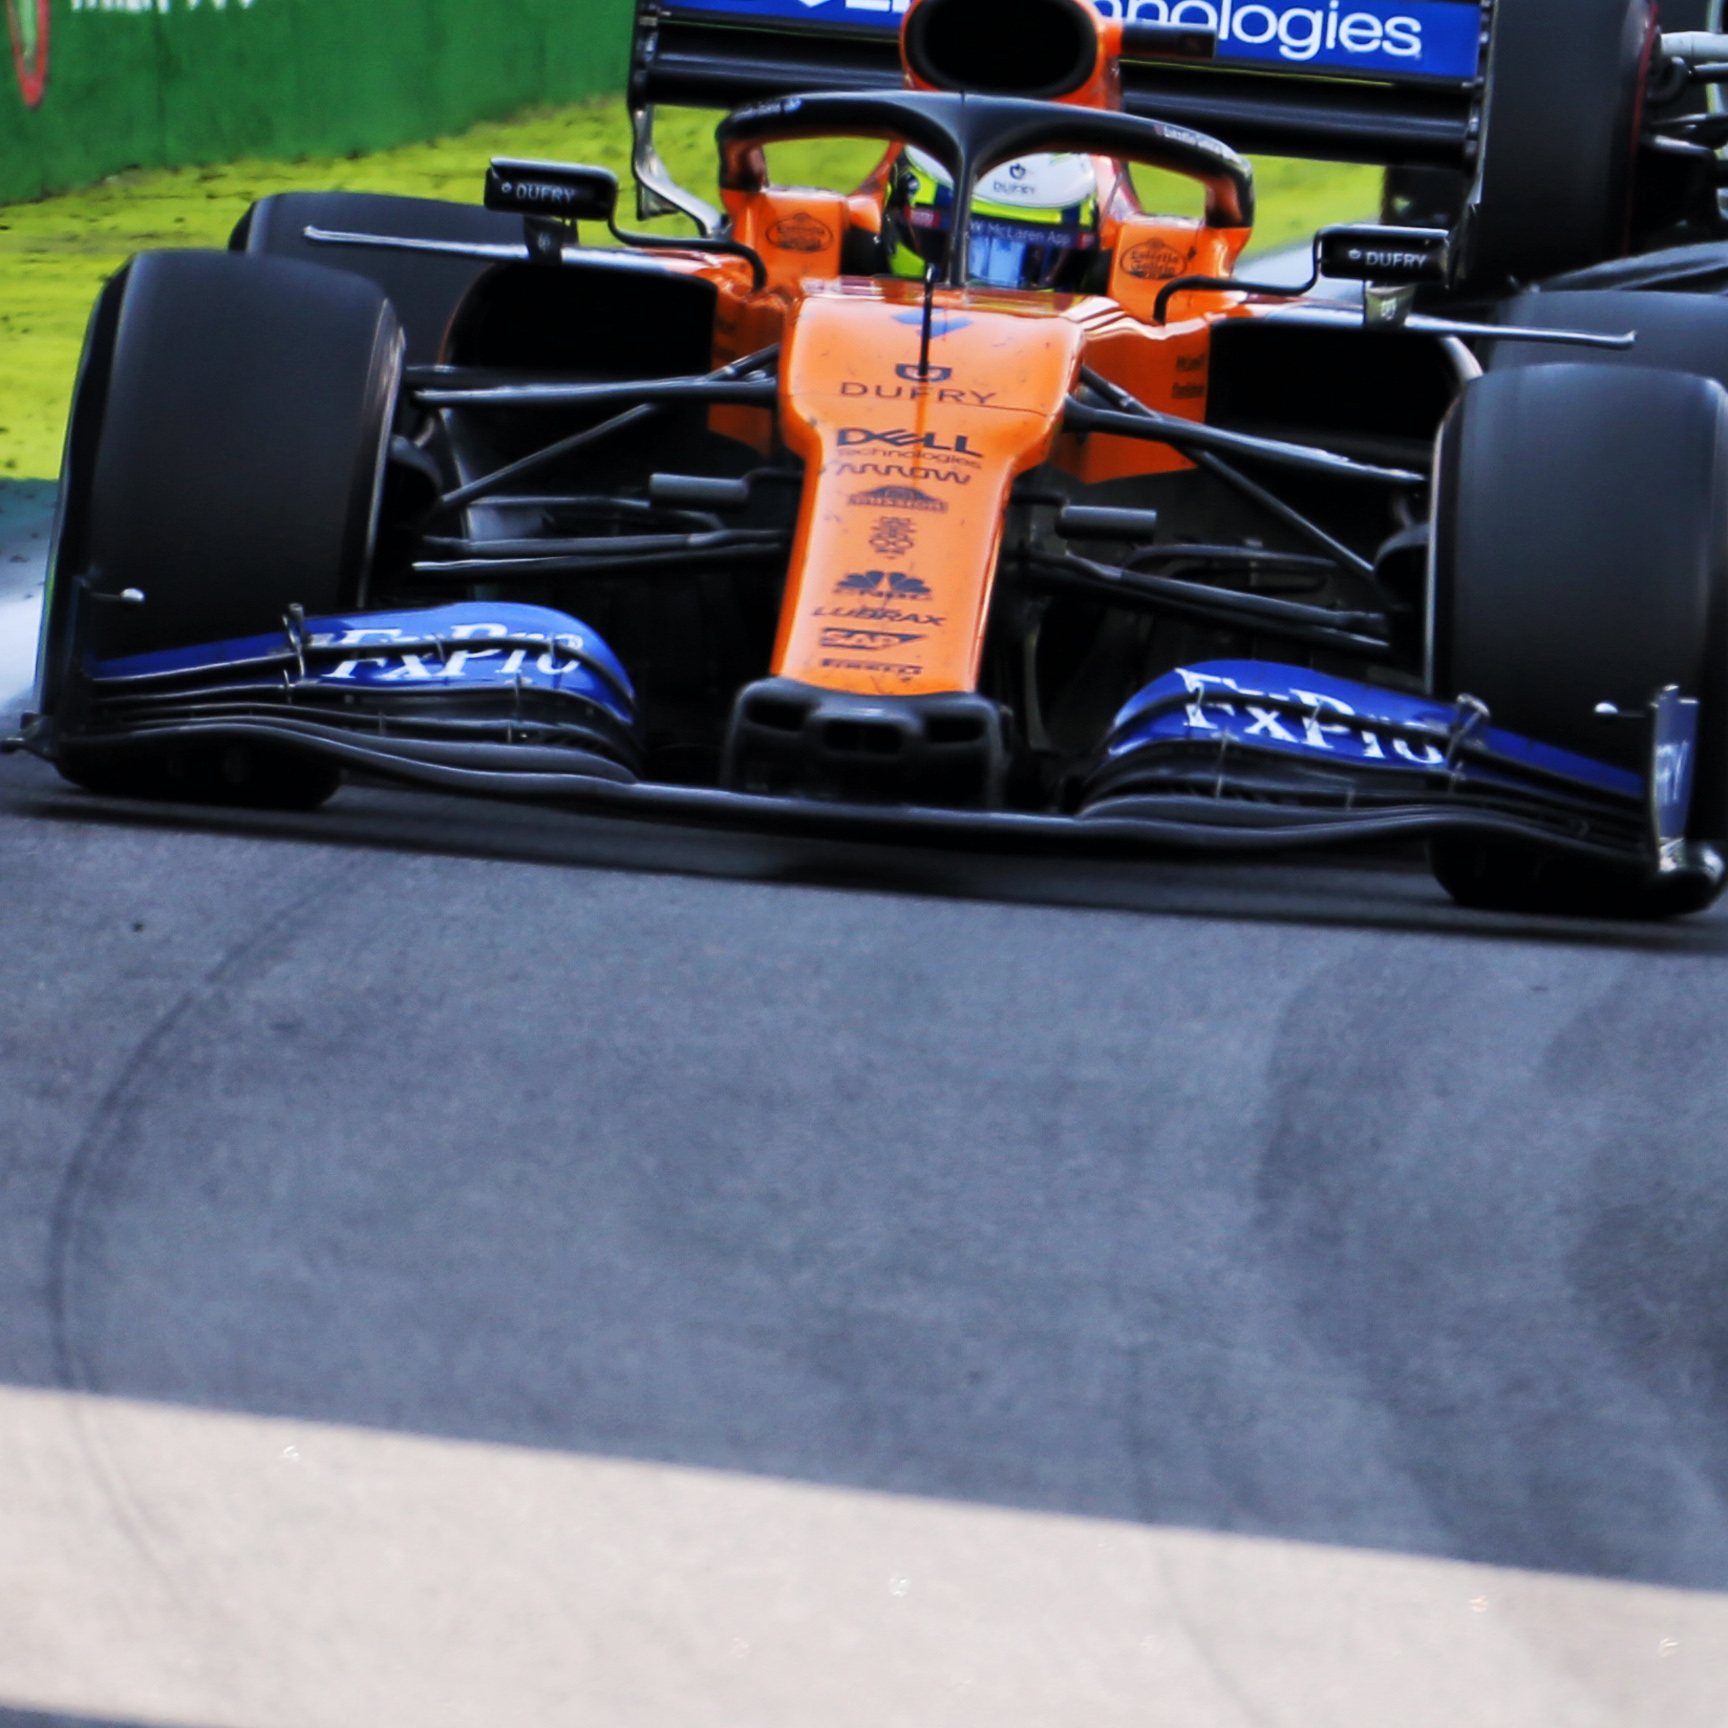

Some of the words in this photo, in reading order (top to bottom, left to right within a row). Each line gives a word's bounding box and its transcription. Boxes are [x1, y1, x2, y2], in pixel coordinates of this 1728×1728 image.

[1365, 251, 1428, 269] DUFRY
[839, 381, 996, 404] DUFRY
[837, 427, 984, 458] DELL
